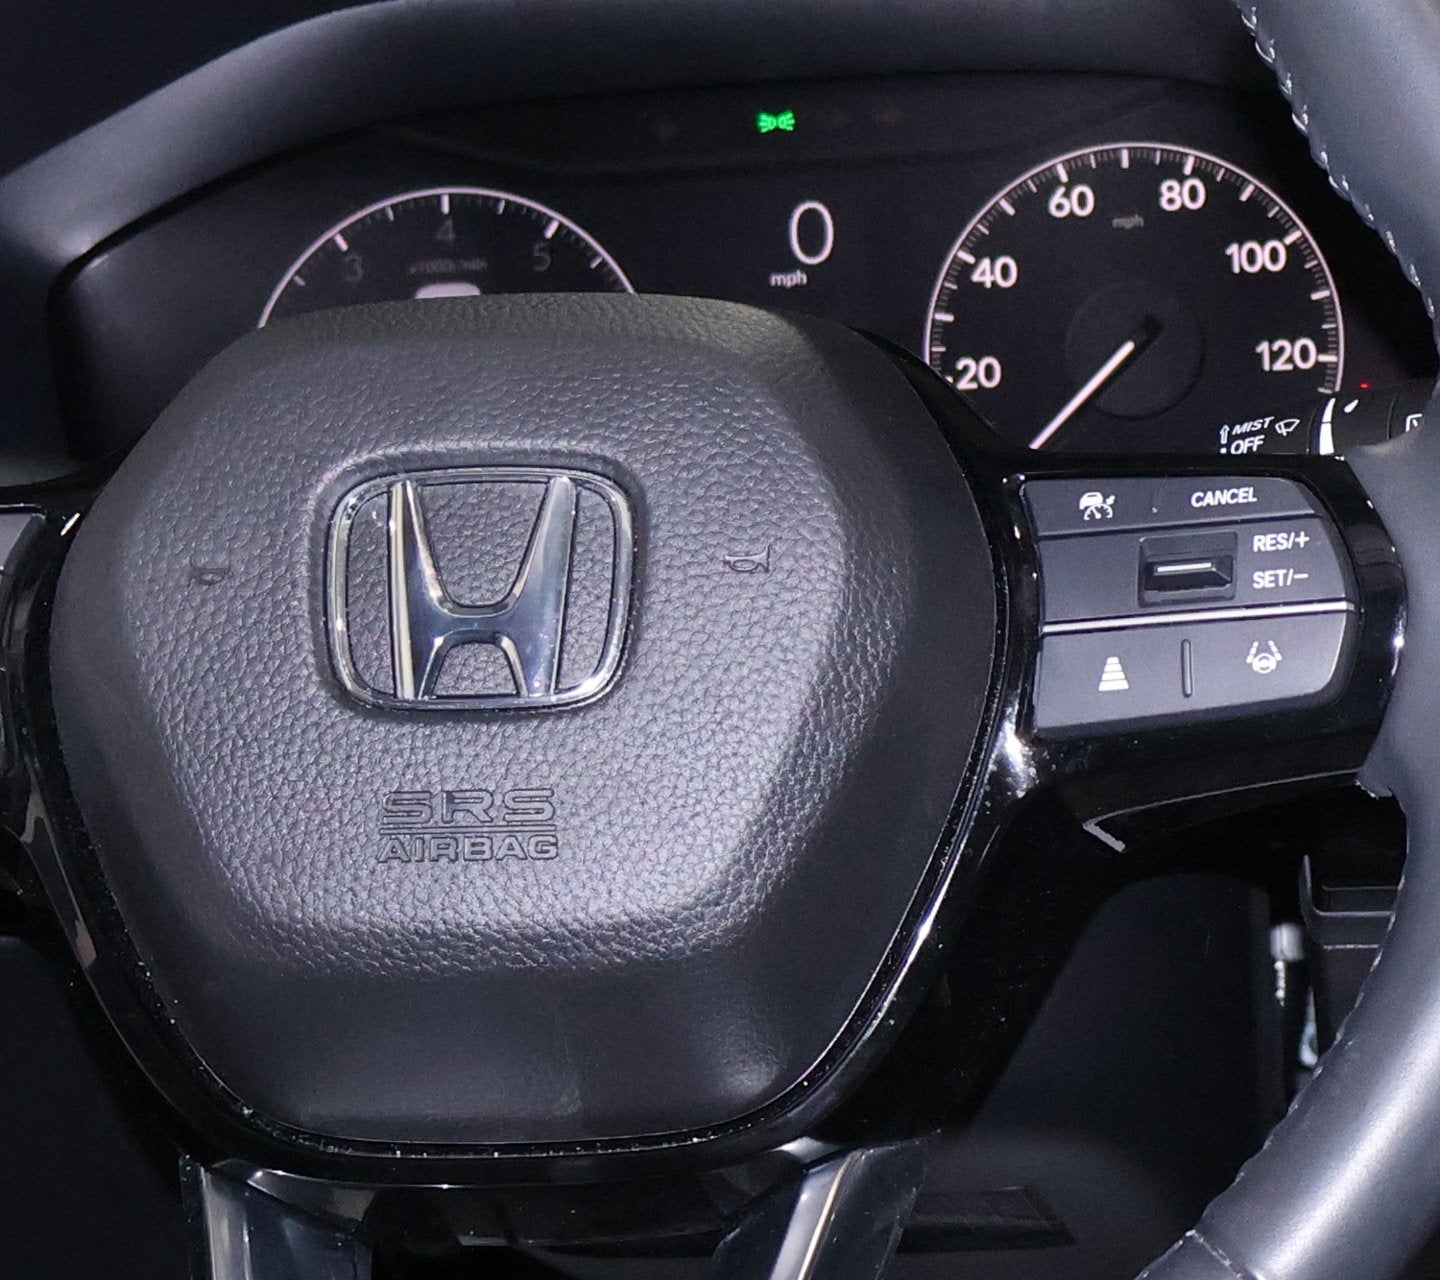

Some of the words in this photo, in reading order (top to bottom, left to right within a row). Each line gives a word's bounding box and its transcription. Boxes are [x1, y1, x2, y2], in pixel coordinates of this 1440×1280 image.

[1048, 183, 1095, 218] 60
[1159, 178, 1207, 213] 80
[789, 201, 834, 265] 0
[971, 255, 1019, 290] 40
[1225, 239, 1288, 276] 100
[770, 270, 808, 288] mph
[1255, 337, 1317, 373] 120
[957, 356, 1002, 391] 20
[1231, 416, 1276, 435] MIST
[1230, 434, 1266, 455] OFF
[1190, 486, 1258, 508] CANCEL
[1252, 531, 1310, 553] RES/+
[382, 788, 556, 824] SRS
[378, 835, 559, 863] AIRBAG
